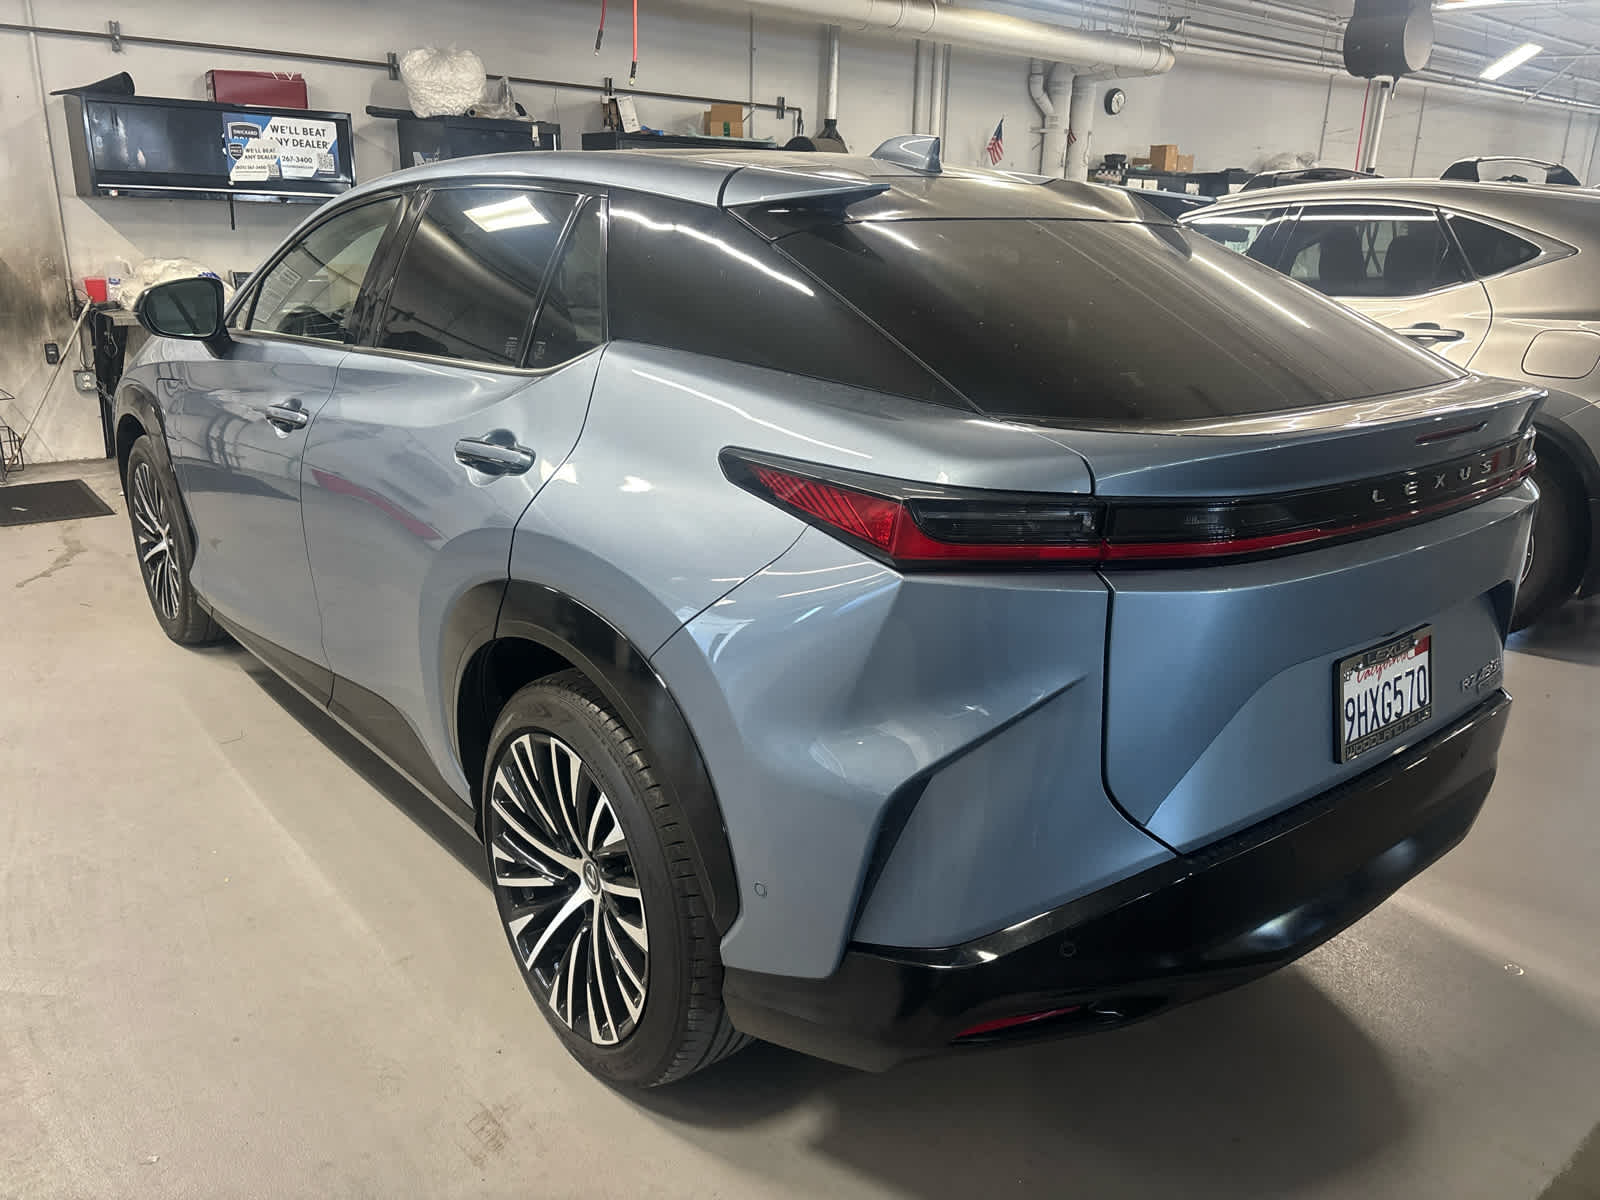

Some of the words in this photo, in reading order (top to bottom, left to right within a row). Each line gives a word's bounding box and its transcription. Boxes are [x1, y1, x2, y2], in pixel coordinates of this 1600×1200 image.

[269, 137, 290, 147] NY
[270, 124, 300, 135] WE'LL
[302, 127, 326, 137] BEAT
[1371, 460, 1493, 503] LEXUS
[1344, 664, 1428, 744] 9HXG570
